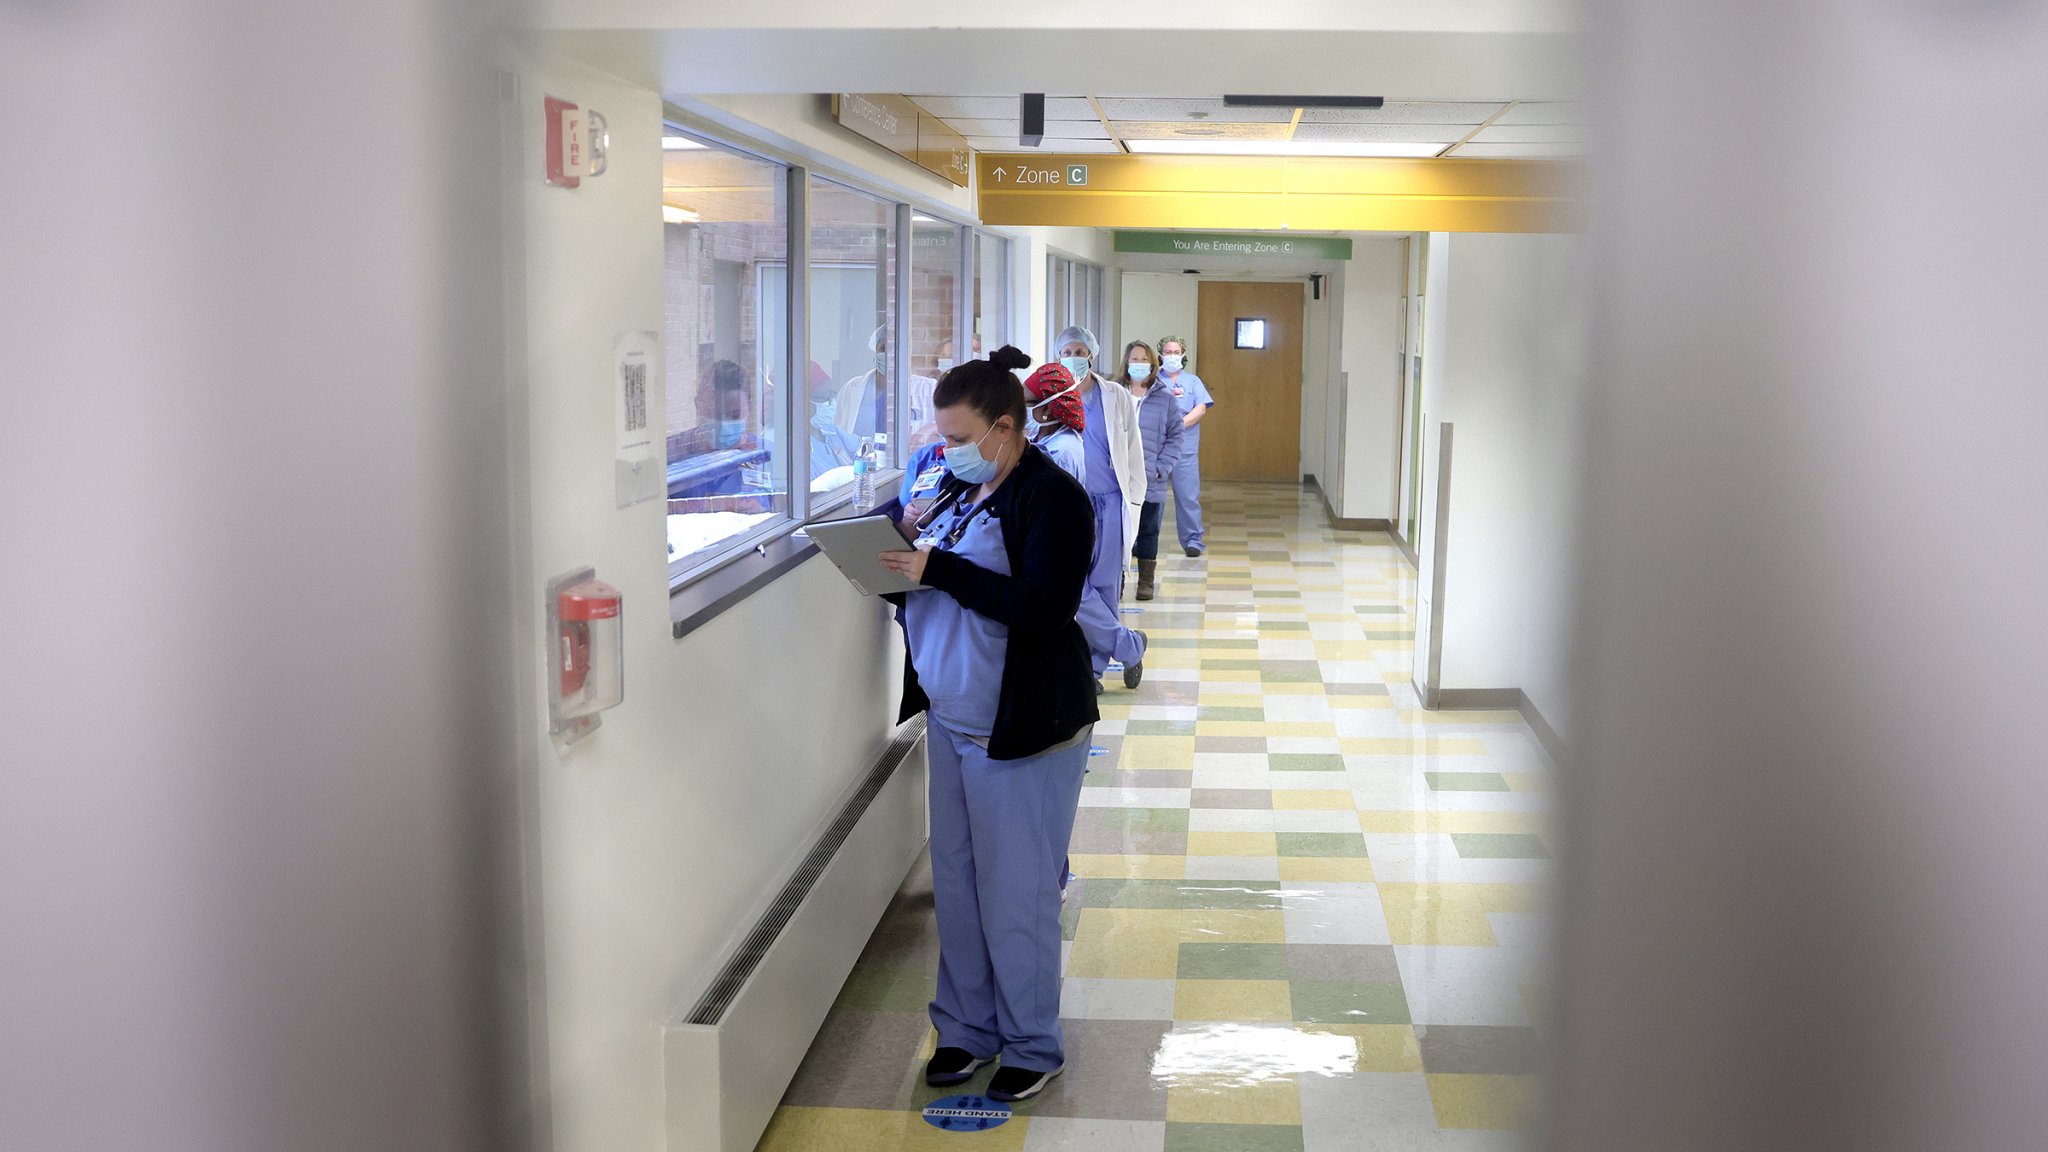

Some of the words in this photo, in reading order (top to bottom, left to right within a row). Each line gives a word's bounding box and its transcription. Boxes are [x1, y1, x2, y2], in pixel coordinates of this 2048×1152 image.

[570, 120, 580, 165] FIRE
[1016, 165, 1060, 184] Zone
[1071, 168, 1082, 182] C
[1174, 240, 1190, 250] You
[1194, 240, 1209, 250] Are
[1214, 241, 1251, 253] Entering
[1255, 242, 1278, 252] Zone
[965, 1110, 1008, 1118] STAND
